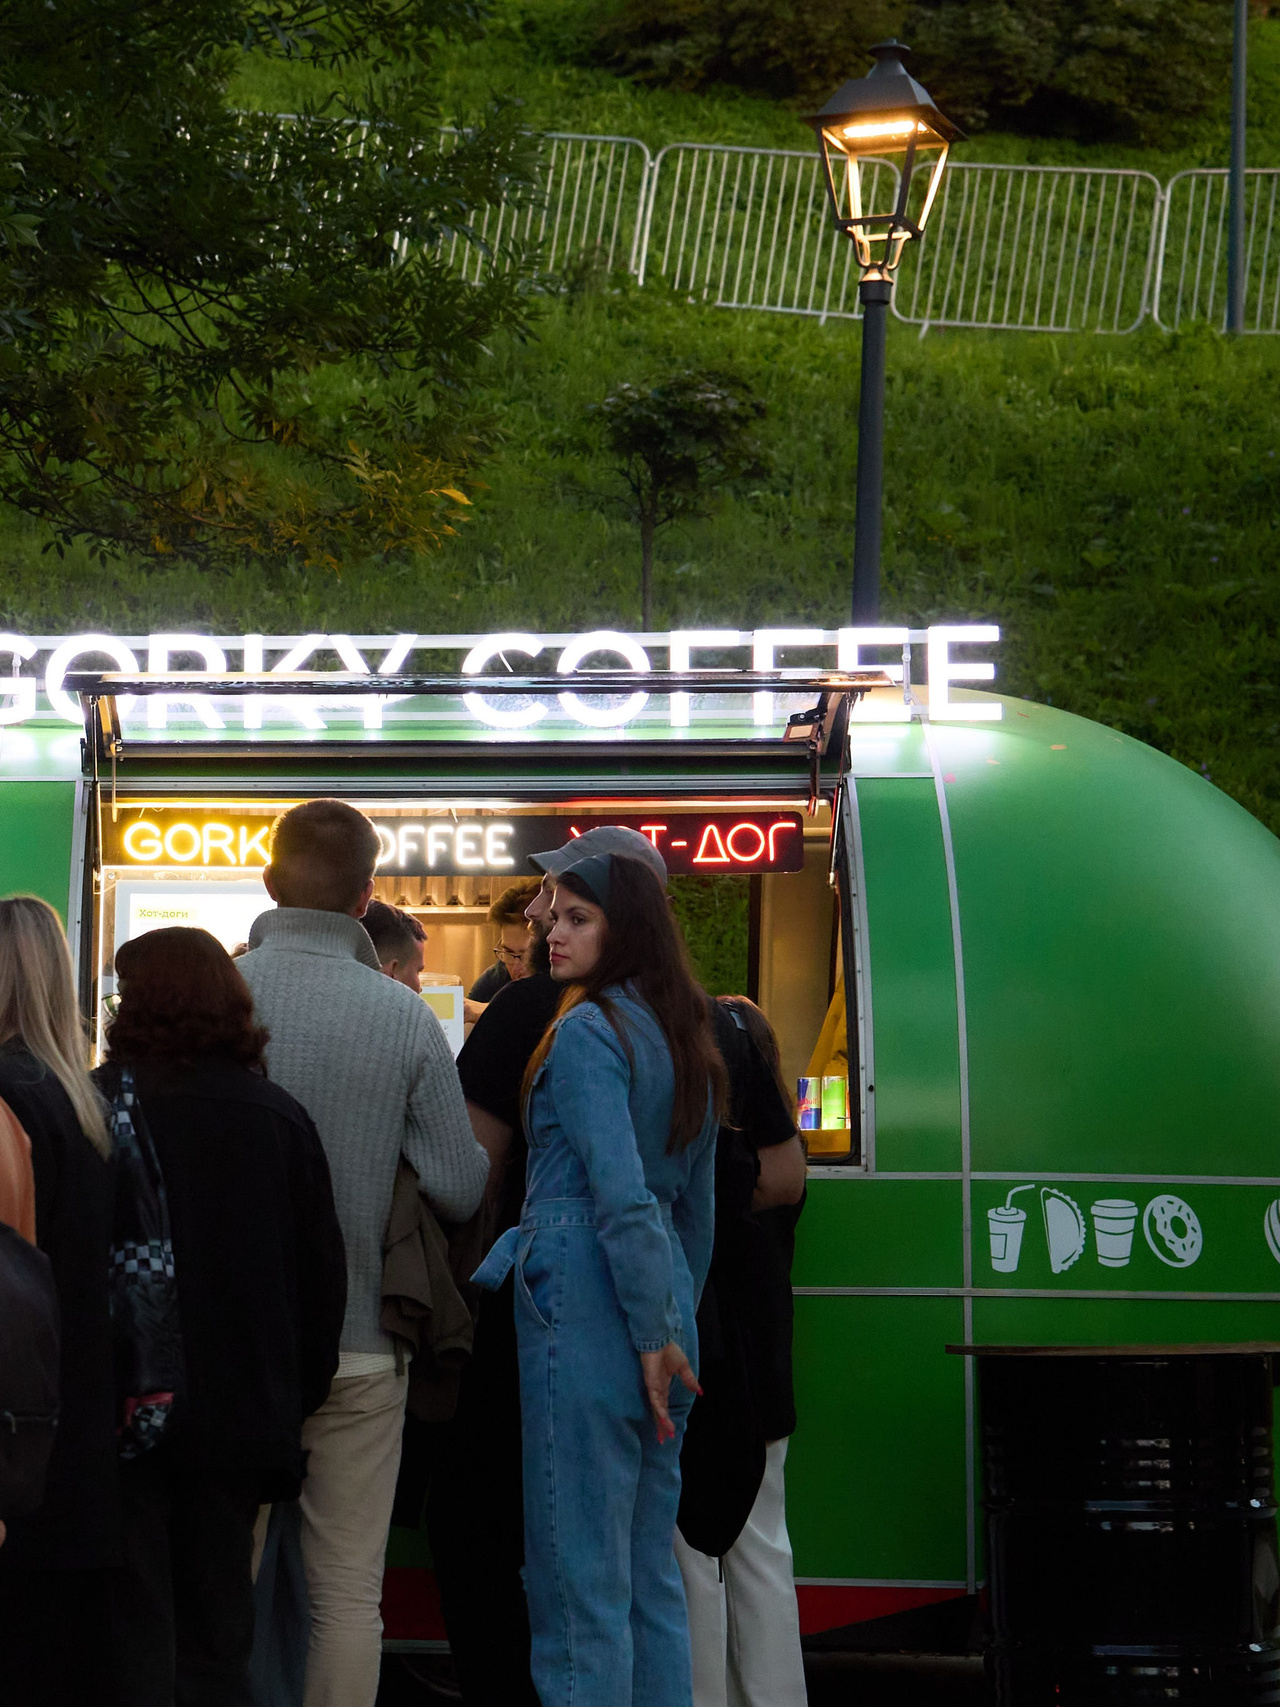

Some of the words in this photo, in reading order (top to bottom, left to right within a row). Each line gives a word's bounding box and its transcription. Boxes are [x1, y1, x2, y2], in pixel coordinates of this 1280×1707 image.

[461, 625, 1003, 729] COFFEE
[123, 821, 272, 865] GORK
[375, 824, 515, 867] OFFEE
[570, 822, 797, 863] Т-ДОГ
[139, 909, 189, 919] Хот-доги
